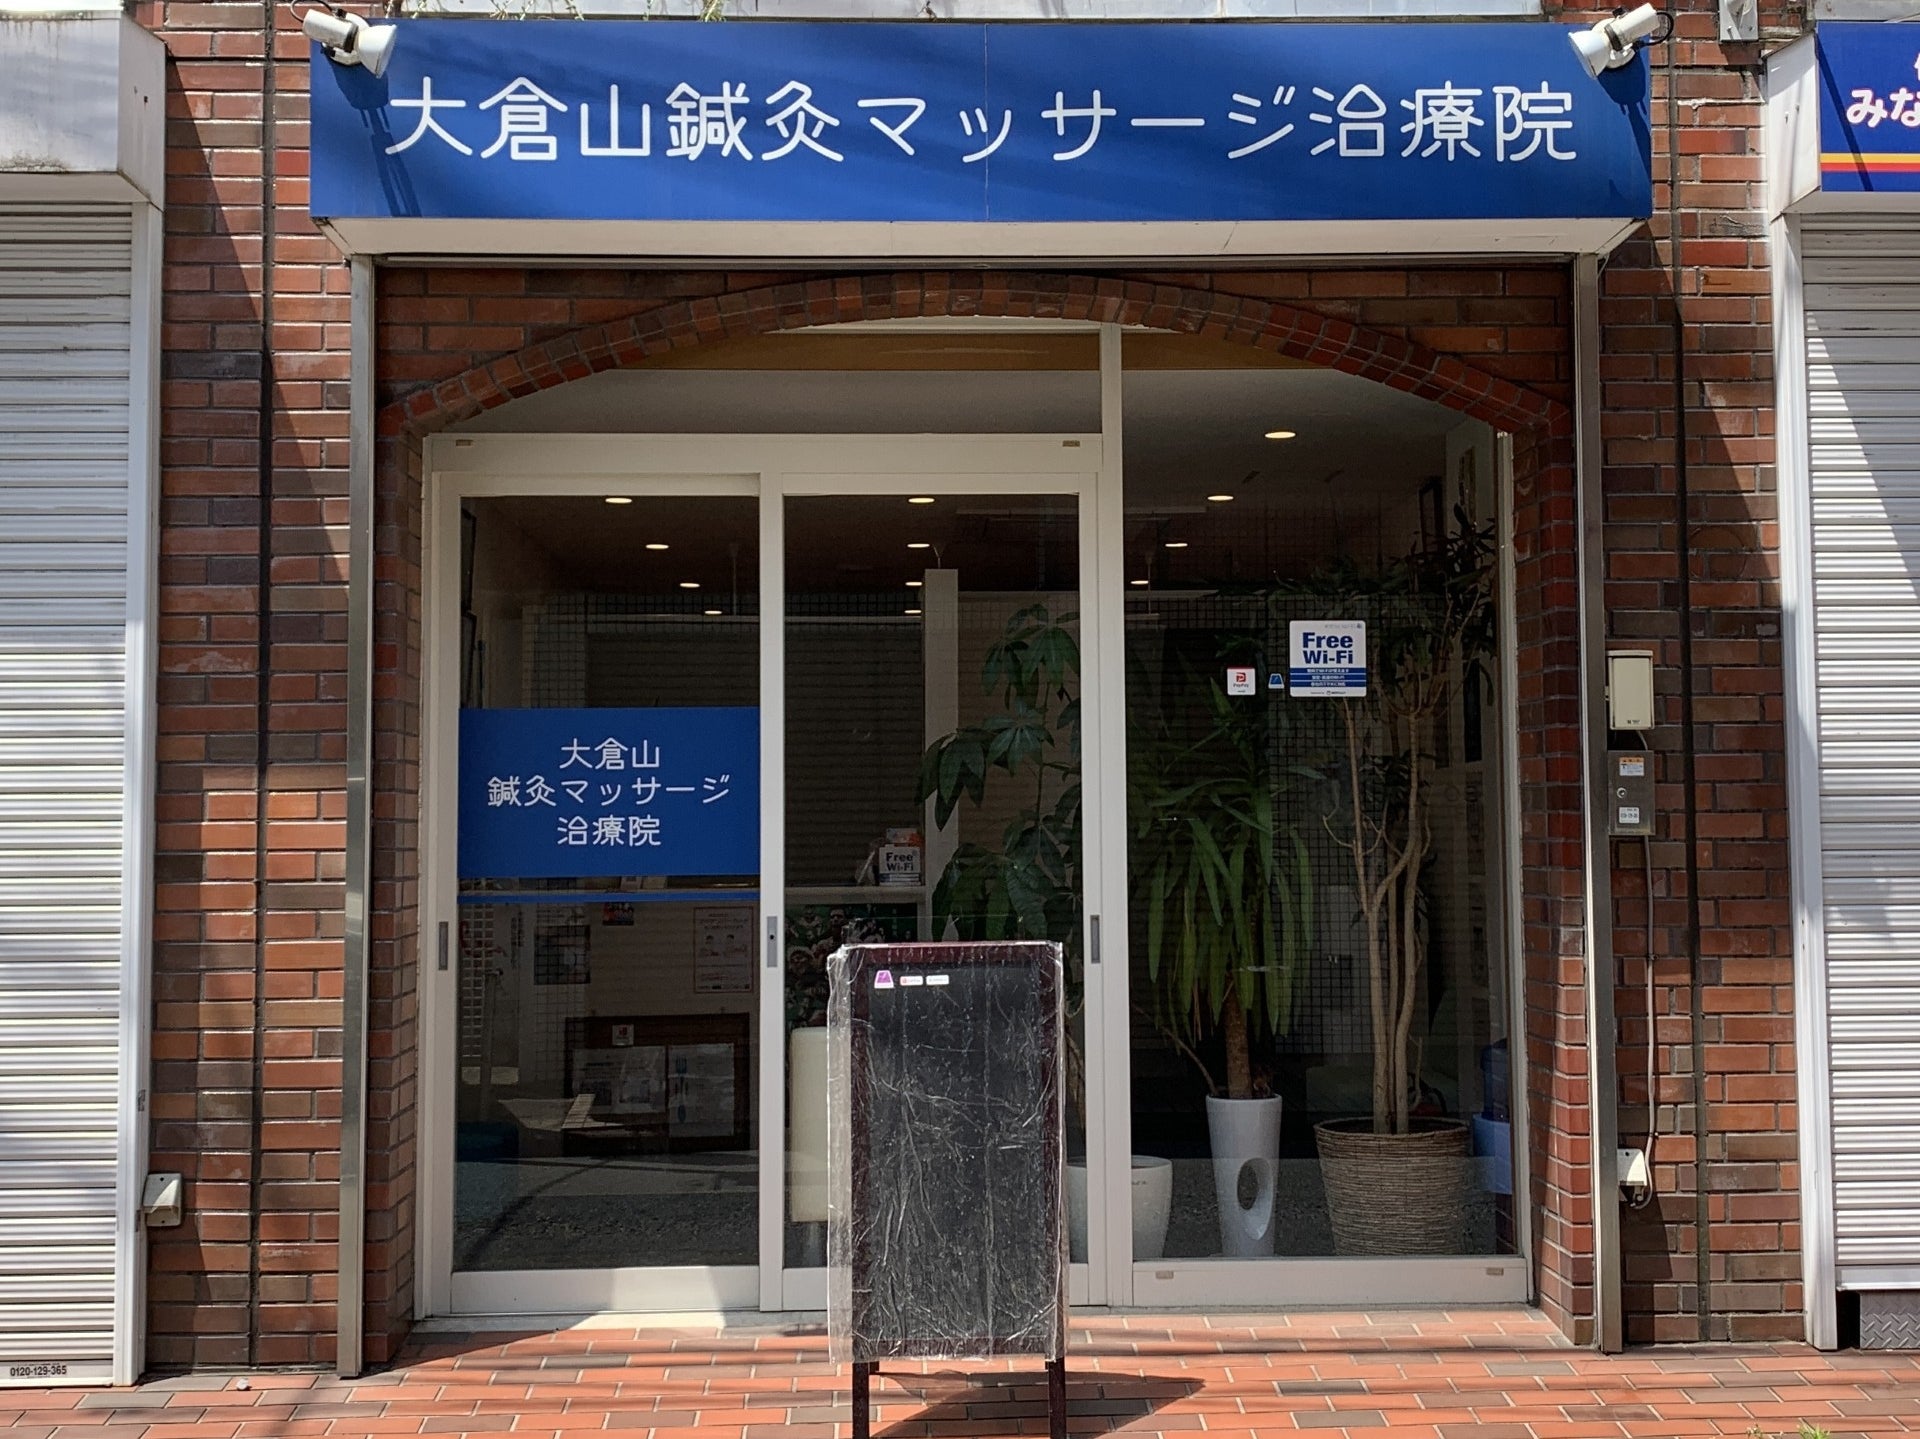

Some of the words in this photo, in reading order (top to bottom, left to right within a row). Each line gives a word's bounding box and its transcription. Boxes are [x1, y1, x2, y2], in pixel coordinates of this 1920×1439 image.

[385, 75, 1577, 162] 大倉山鍼灸マッサージ治療院
[1303, 632, 1353, 648] Free
[1303, 650, 1353, 664] Wi-Fi
[559, 737, 660, 770] 大倉山
[487, 774, 730, 807] 鍼灸マッサージ
[557, 814, 662, 847] 治療院
[886, 852, 913, 862] Free
[886, 862, 914, 871] Wi-Fi
[10, 1365, 67, 1377] 0120-129-365
